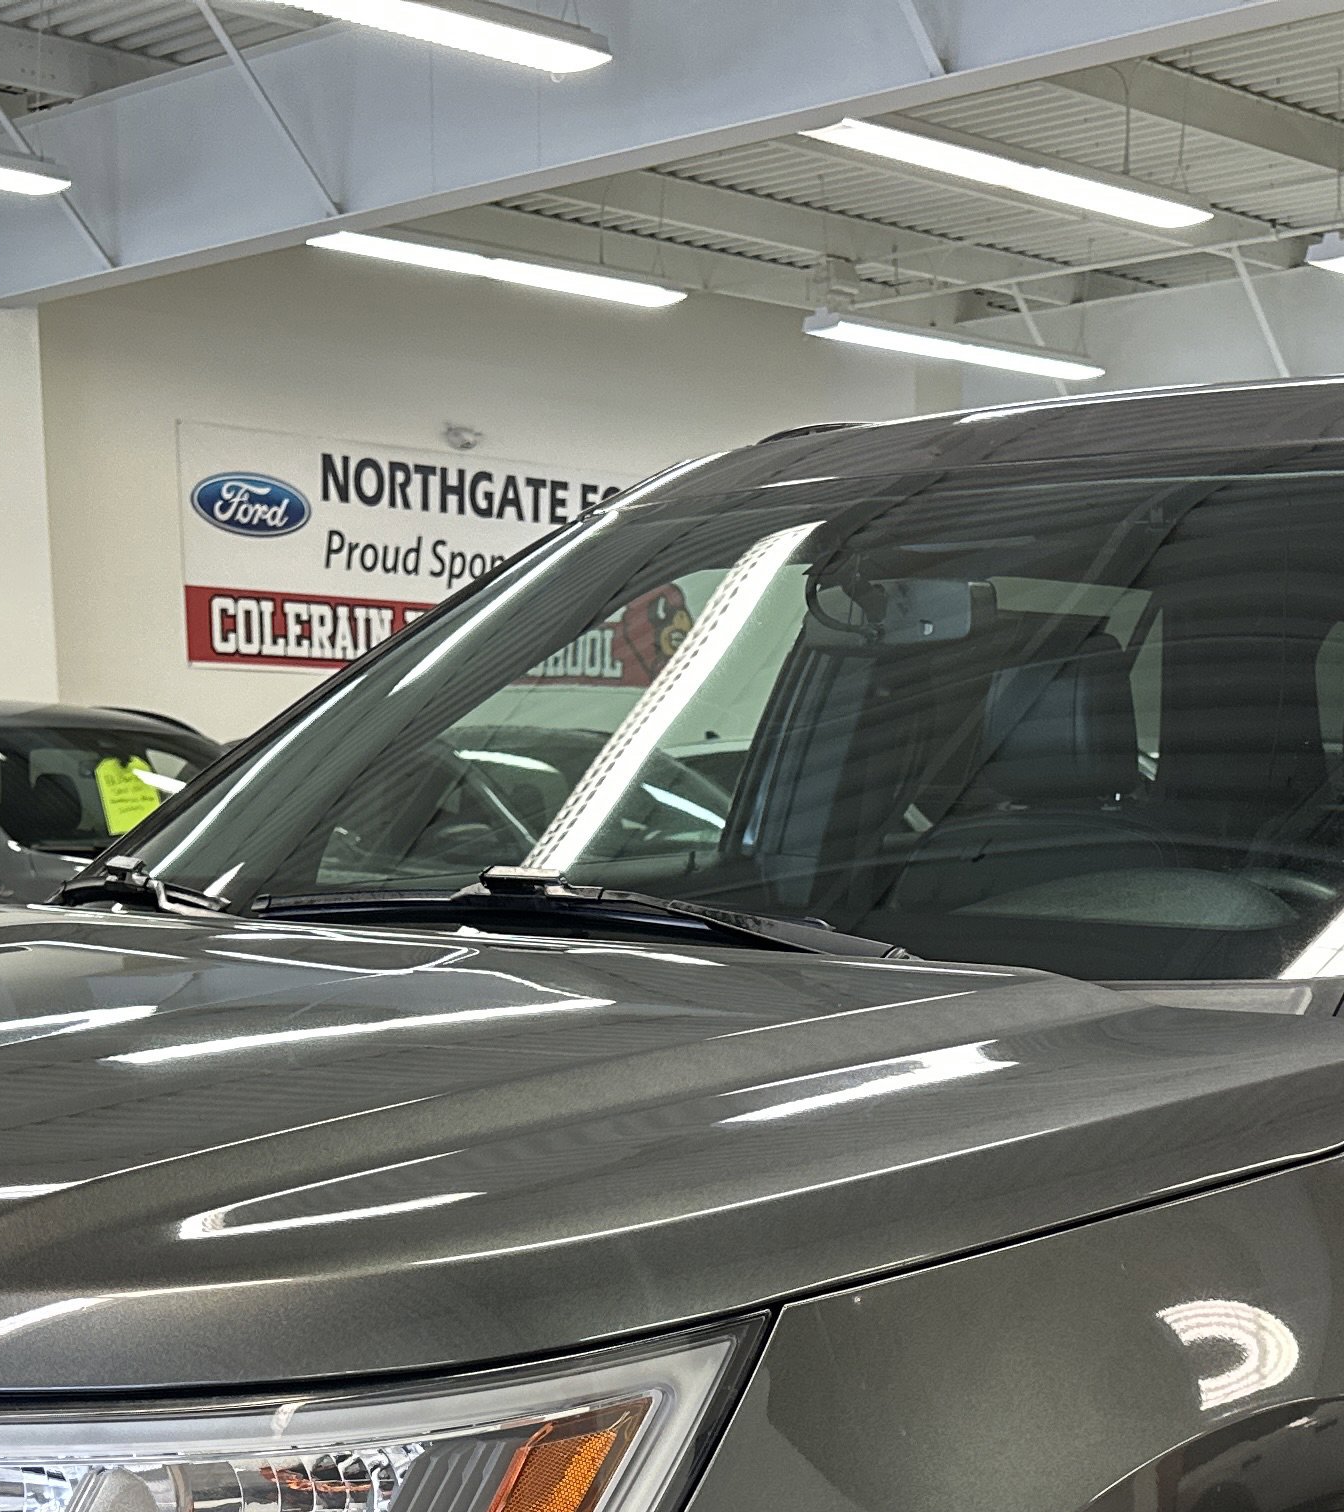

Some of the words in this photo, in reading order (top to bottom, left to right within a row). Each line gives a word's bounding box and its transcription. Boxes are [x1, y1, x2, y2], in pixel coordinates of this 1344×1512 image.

[213, 481, 290, 527] Ford
[320, 453, 569, 525] NORTHGATE
[325, 530, 422, 577] Proud
[211, 594, 394, 661] COLERAIN
